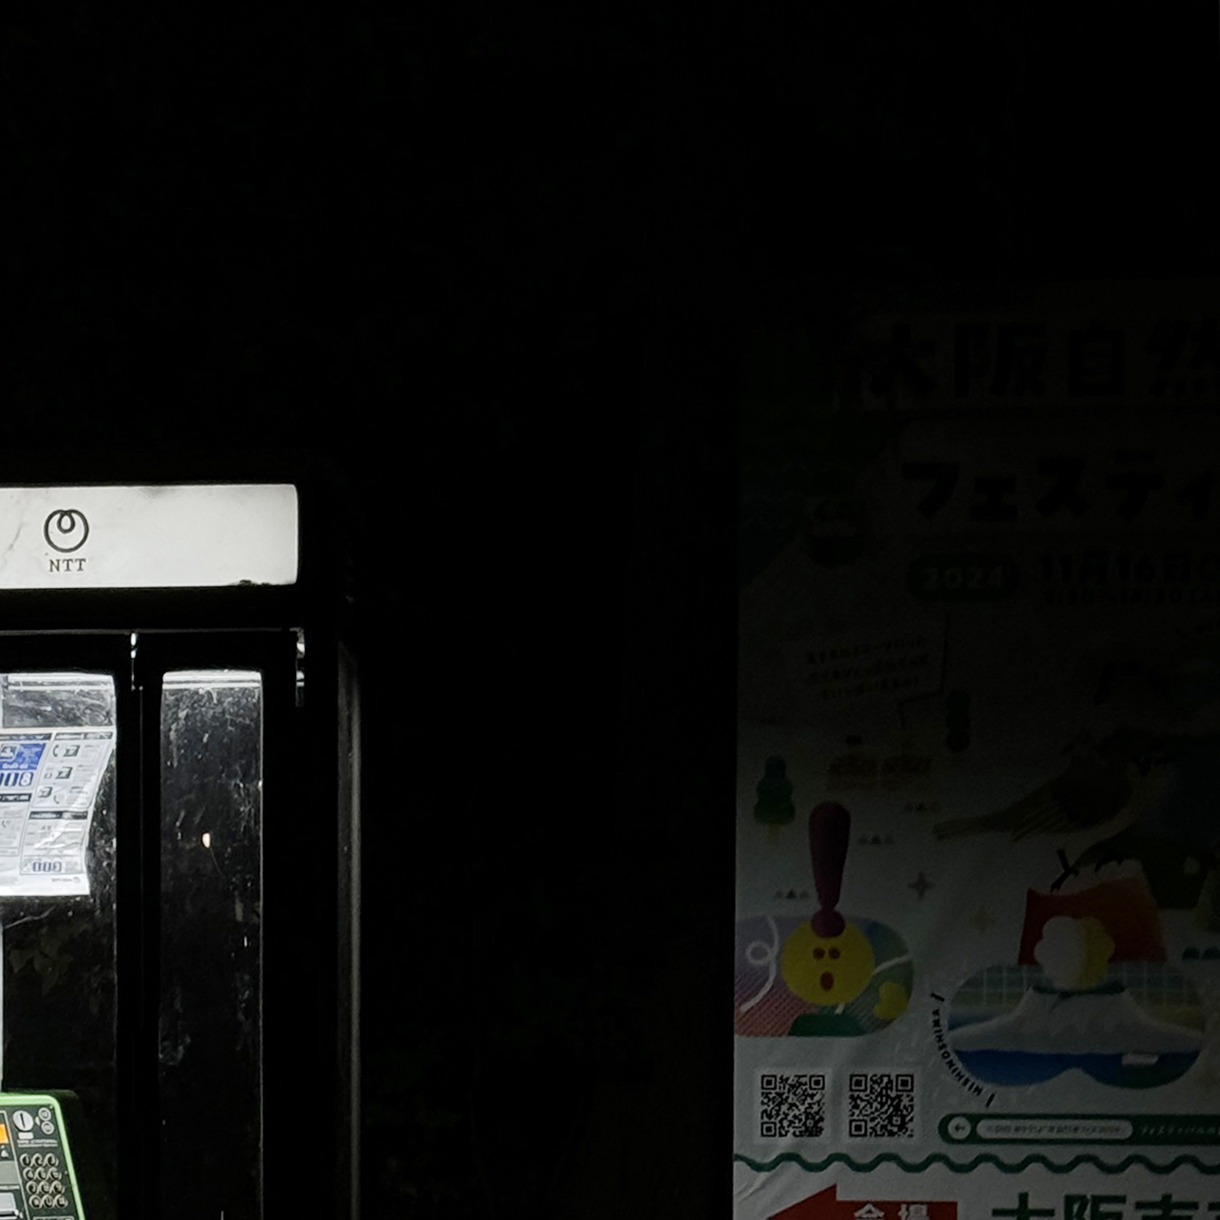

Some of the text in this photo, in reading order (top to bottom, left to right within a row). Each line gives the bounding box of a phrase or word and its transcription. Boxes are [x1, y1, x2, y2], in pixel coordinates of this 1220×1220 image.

[48, 558, 87, 573] NTT
[922, 564, 1007, 592] 2024
[931, 1007, 984, 1097] NISHINOSHIMA
